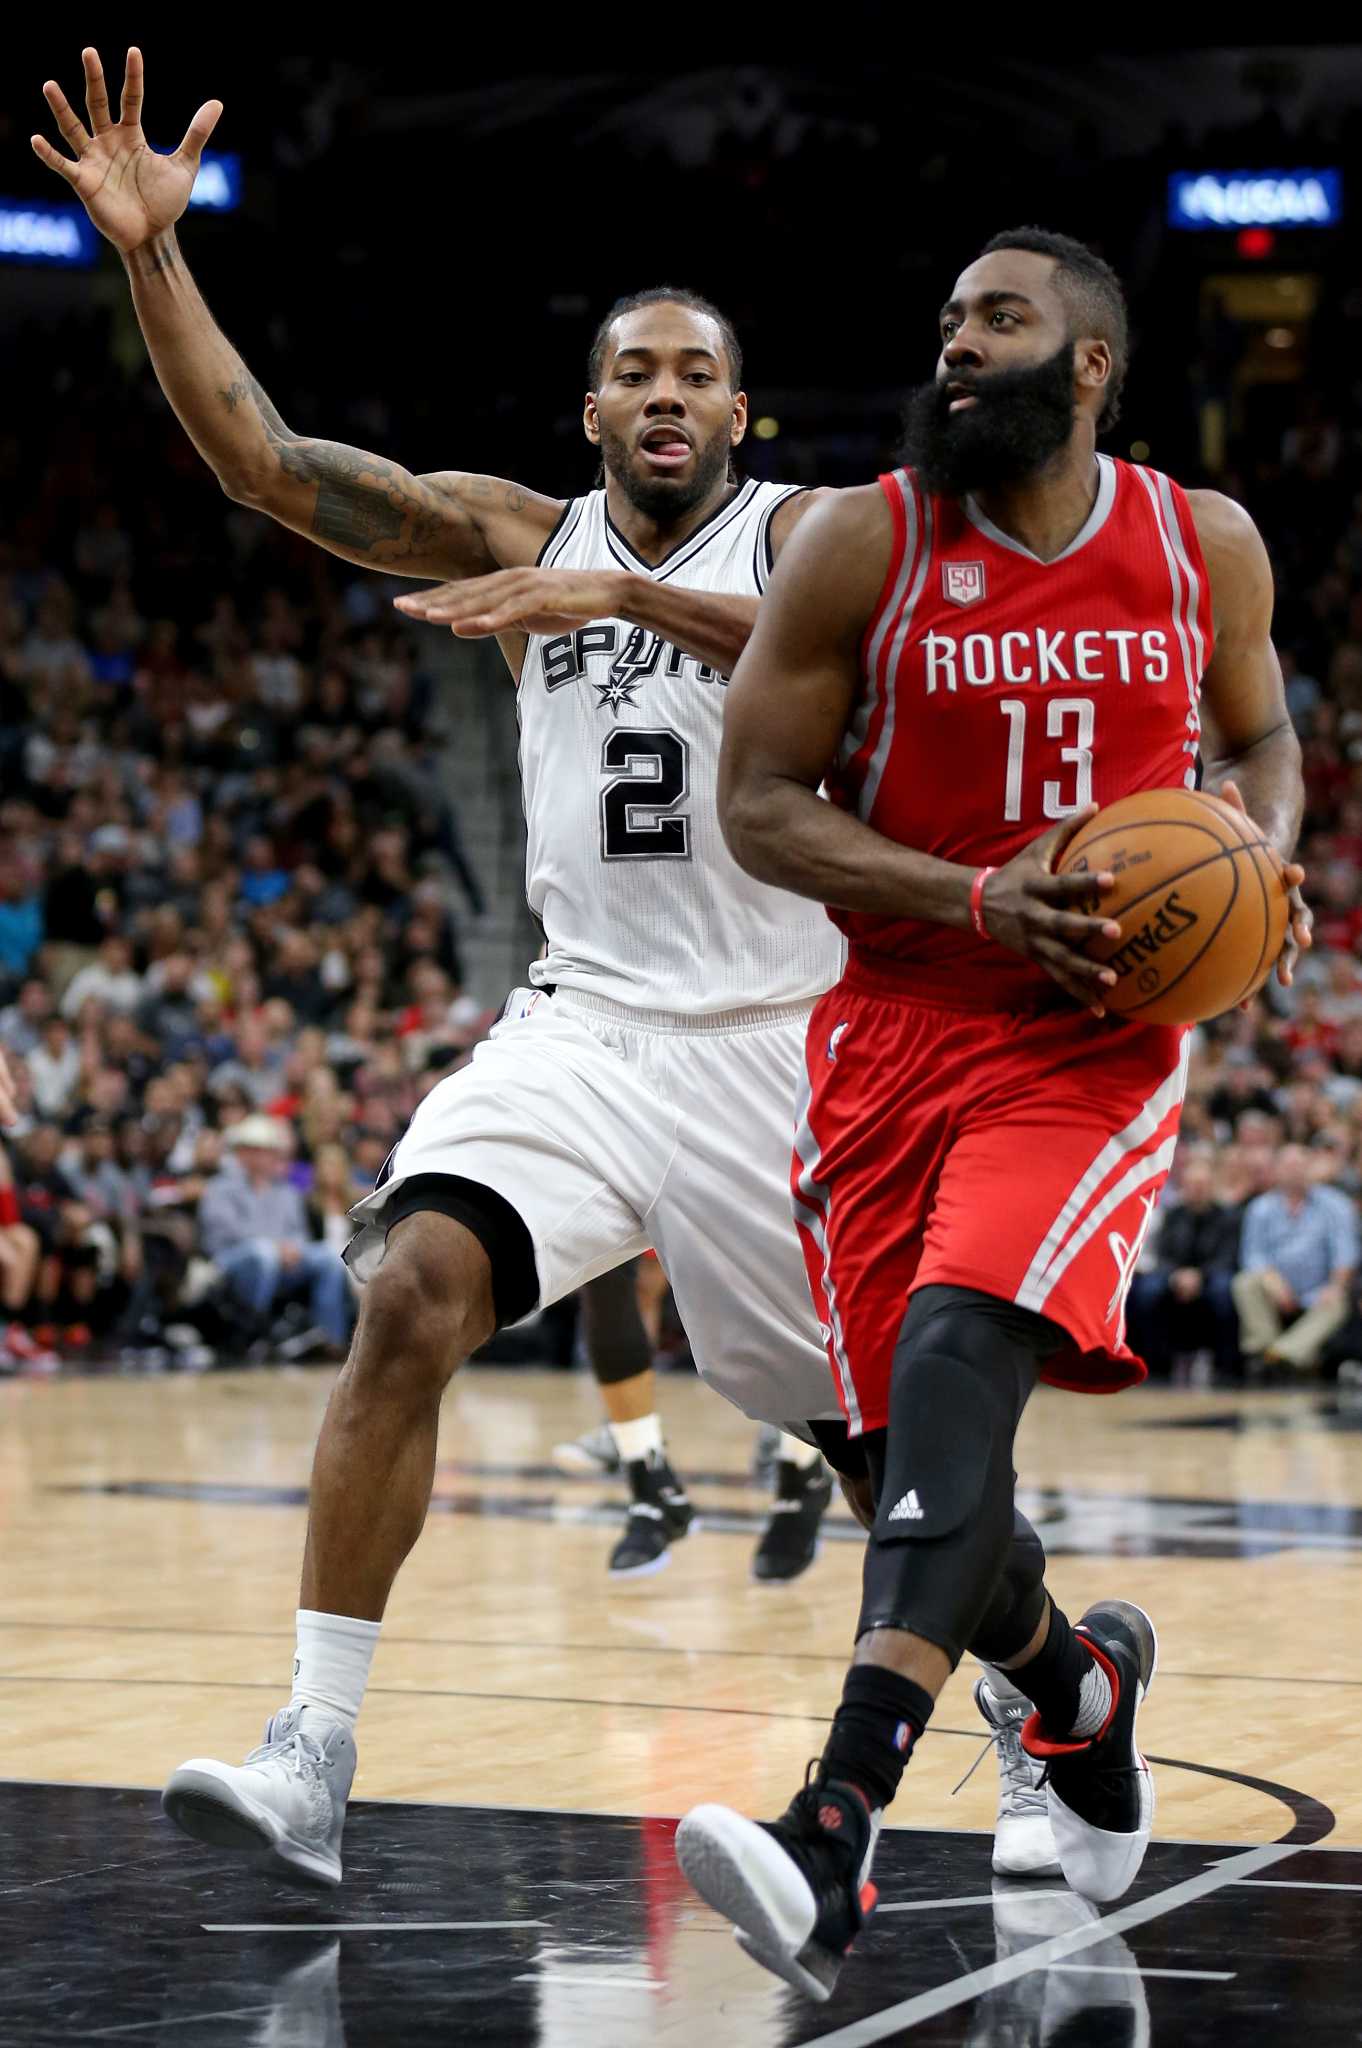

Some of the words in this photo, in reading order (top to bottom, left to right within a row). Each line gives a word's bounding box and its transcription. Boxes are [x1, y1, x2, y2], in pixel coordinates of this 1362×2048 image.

[950, 567, 977, 588] 50
[541, 624, 730, 693] SPU
[919, 627, 1169, 696] ROCKETS
[601, 726, 691, 861] 2
[1000, 698, 1095, 822] 13
[1106, 890, 1198, 977] SPALD
